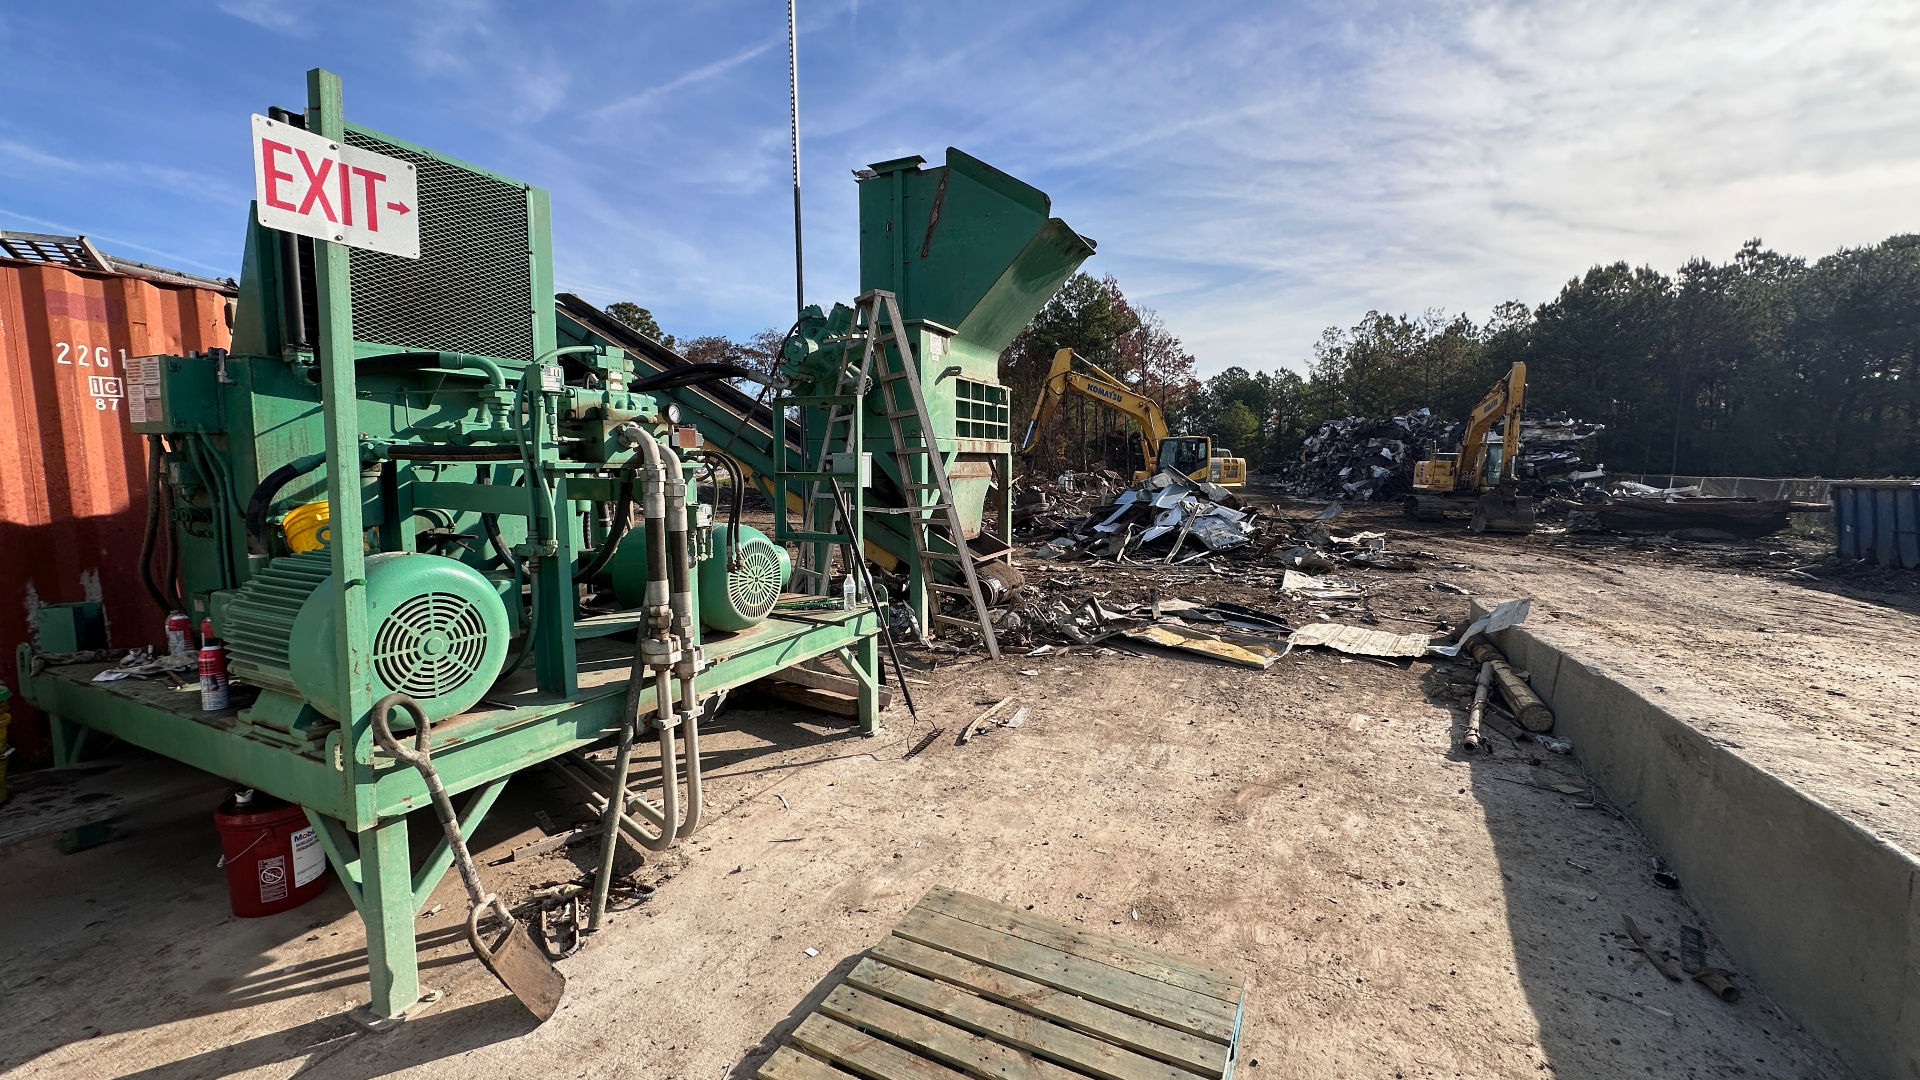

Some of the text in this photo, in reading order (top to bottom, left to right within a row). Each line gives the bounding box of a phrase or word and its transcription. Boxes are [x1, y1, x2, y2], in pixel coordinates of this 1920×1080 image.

[262, 138, 387, 232] EXIT
[56, 342, 127, 370] 22G1
[1087, 383, 1122, 402] KOMATSU
[95, 398, 119, 411] 87
